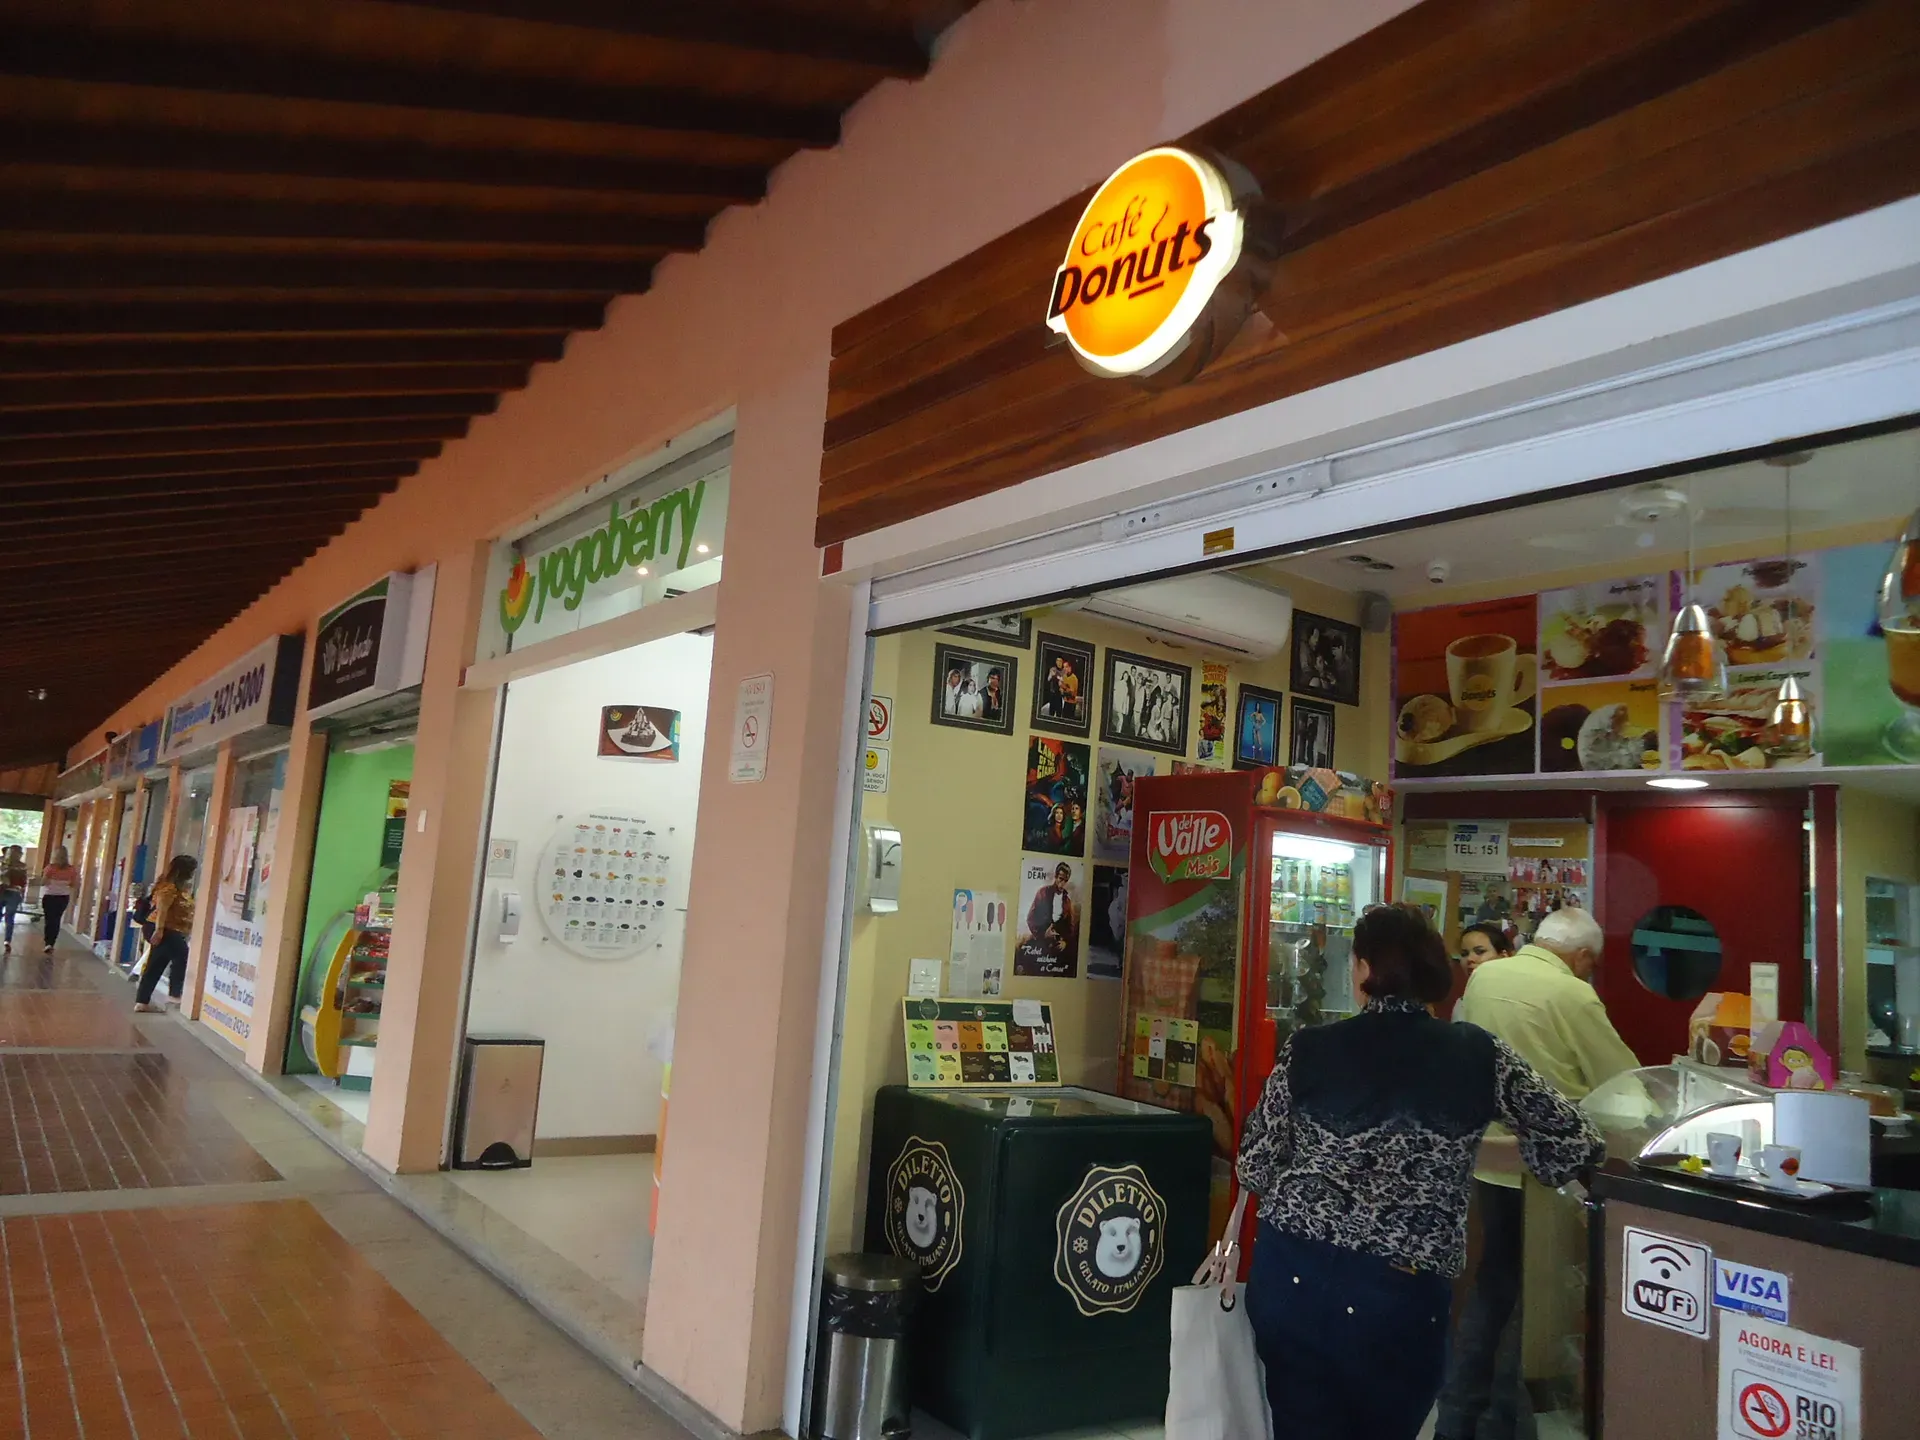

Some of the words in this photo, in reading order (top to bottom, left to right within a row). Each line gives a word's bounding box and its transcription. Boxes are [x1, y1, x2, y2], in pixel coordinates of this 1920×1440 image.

[1081, 195, 1147, 256] Café
[1049, 215, 1216, 320] Donuts
[534, 480, 705, 624] yogoberry
[210, 663, 265, 724] 2421-5000
[1038, 737, 1056, 762] LAND
[1036, 765, 1056, 780] GIANTS
[1158, 816, 1220, 857] Valle
[1179, 814, 1194, 830] del
[1185, 855, 1220, 878] Mais
[1481, 845, 1499, 855] 151
[1027, 871, 1046, 880] DEAN
[233, 1016, 251, 1039] 2421-5
[897, 1155, 951, 1203] DILETTO
[1077, 1183, 1155, 1228] DILETTO
[918, 1236, 947, 1266] ITALIANO
[1078, 1260, 1110, 1294] GELATO
[1113, 1254, 1151, 1294] ITALIANO
[1722, 1268, 1783, 1304] VISA
[1738, 1329, 1793, 1359] AGORA
[1796, 1395, 1837, 1429] RIO
